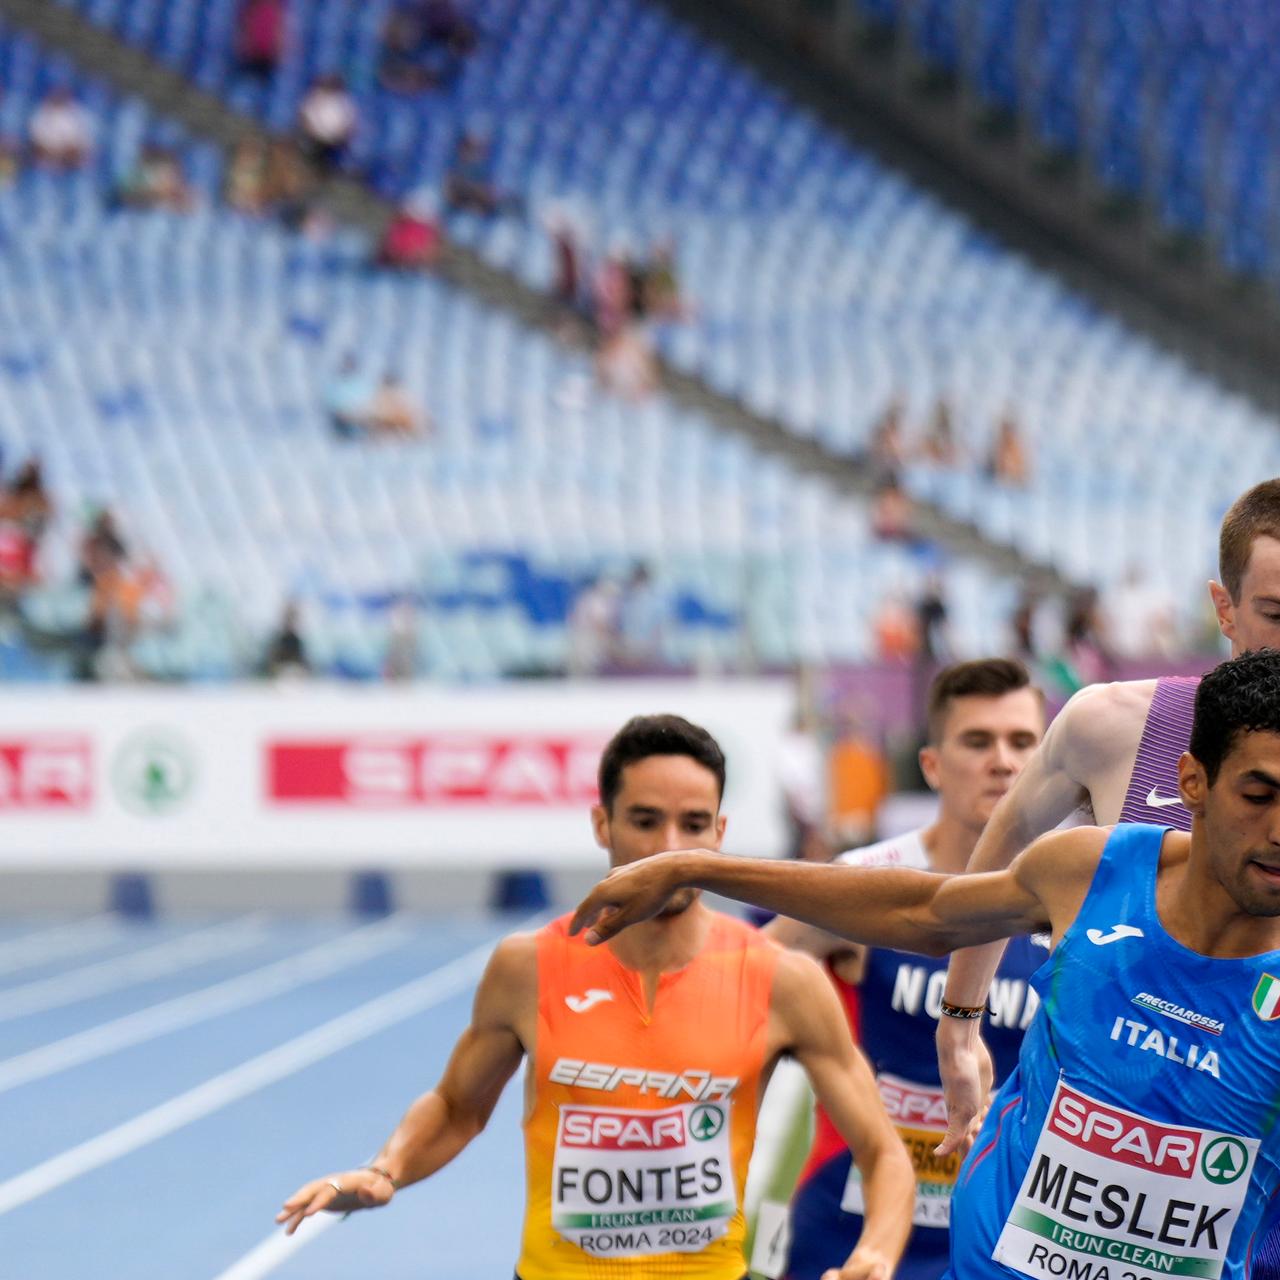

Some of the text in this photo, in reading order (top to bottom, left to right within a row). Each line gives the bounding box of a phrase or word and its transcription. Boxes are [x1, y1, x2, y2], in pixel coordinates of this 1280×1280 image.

[1135, 992, 1225, 1031] FRECCIAROSSA
[1110, 1016, 1220, 1079] ITALIA
[549, 1058, 739, 1100] ESPAÑA
[880, 1086, 948, 1122] SPA
[563, 1114, 683, 1147] SPAR
[1053, 1098, 1196, 1171] SPAR
[557, 1158, 722, 1204] FONTES
[1027, 1154, 1231, 1250] MESLEK
[580, 1225, 714, 1251] ROMA 2024
[1060, 1228, 1105, 1258] RUN
